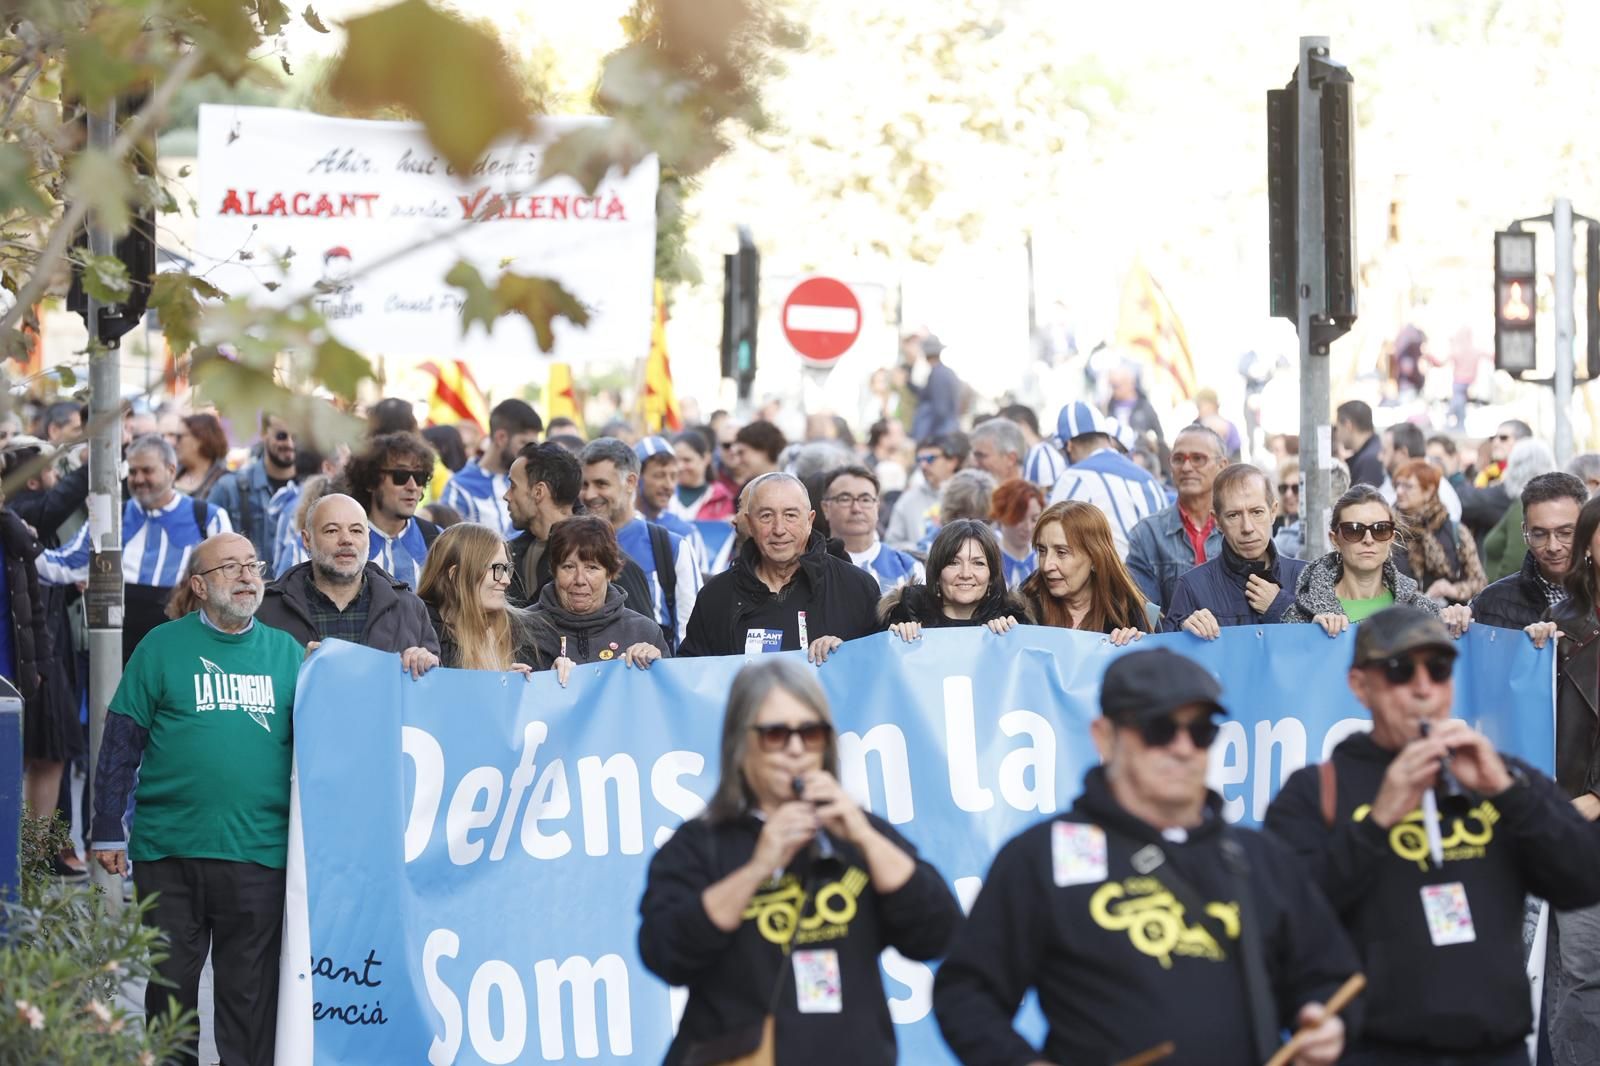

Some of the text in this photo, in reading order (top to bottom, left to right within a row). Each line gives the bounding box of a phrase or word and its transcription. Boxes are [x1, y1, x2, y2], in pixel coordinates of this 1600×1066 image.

[220, 189, 380, 218] ALACANT
[458, 186, 627, 223] VALENCIÀ
[747, 632, 783, 640] ALACANT
[194, 673, 275, 707] LA LLENGUA
[196, 703, 275, 714] NO ES TOCA
[943, 675, 1057, 814] la
[422, 928, 633, 1065] Som
